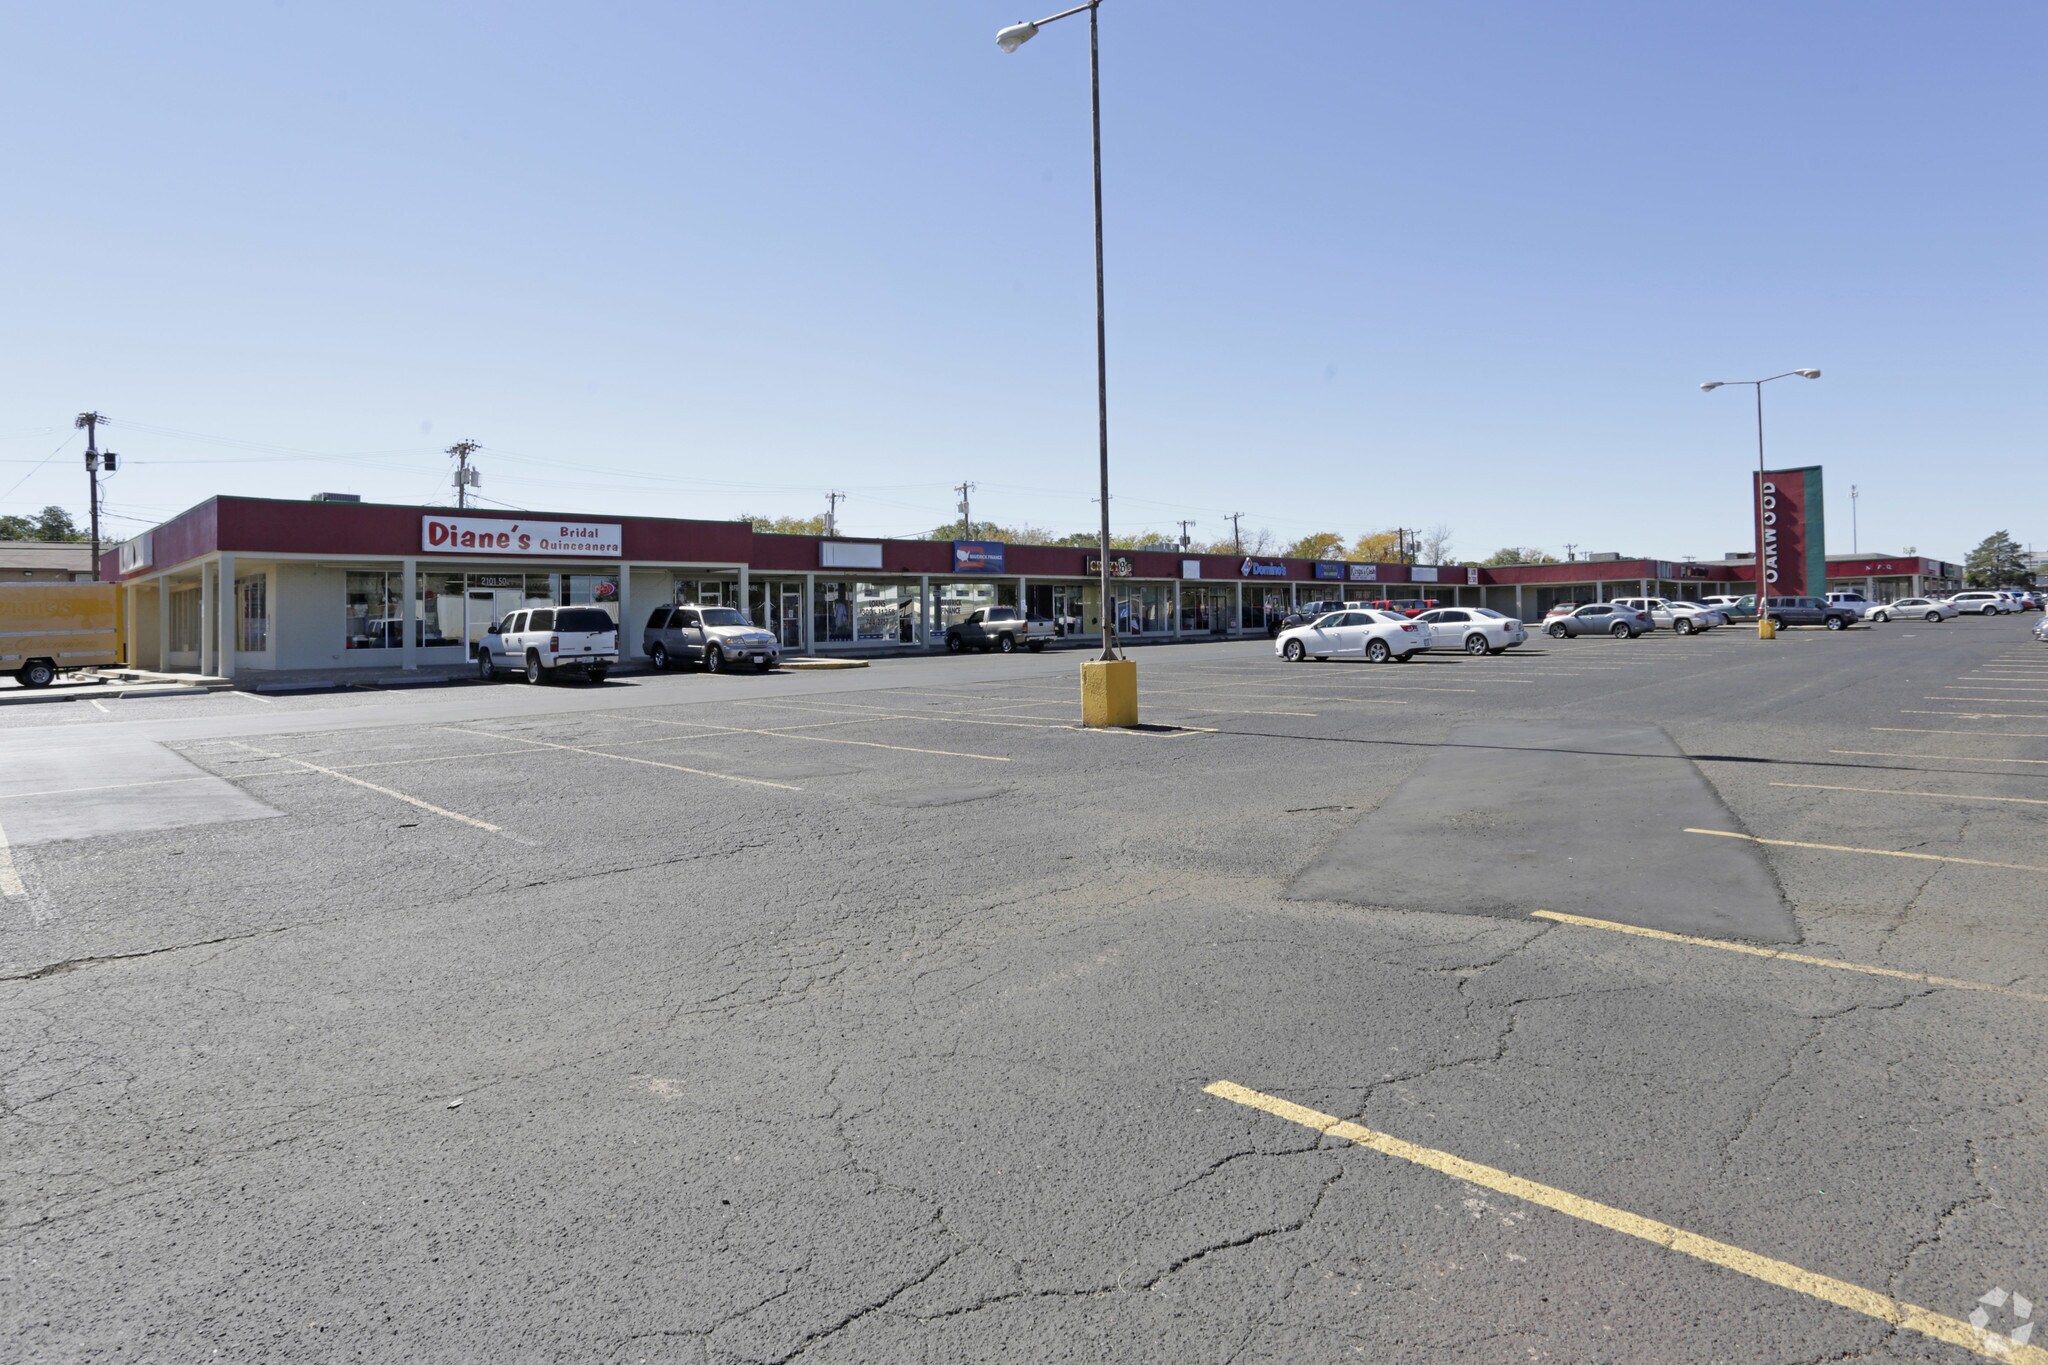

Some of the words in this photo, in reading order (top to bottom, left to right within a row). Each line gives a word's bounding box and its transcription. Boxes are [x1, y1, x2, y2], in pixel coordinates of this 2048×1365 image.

[428, 521, 531, 550] Diane's
[560, 526, 599, 538] Bridal
[1763, 482, 1778, 584] OAKWOOD
[539, 539, 619, 552] Quinceanera
[1252, 561, 1287, 576] Domino's
[481, 576, 496, 586] 2101
[941, 606, 961, 615] FINANCE
